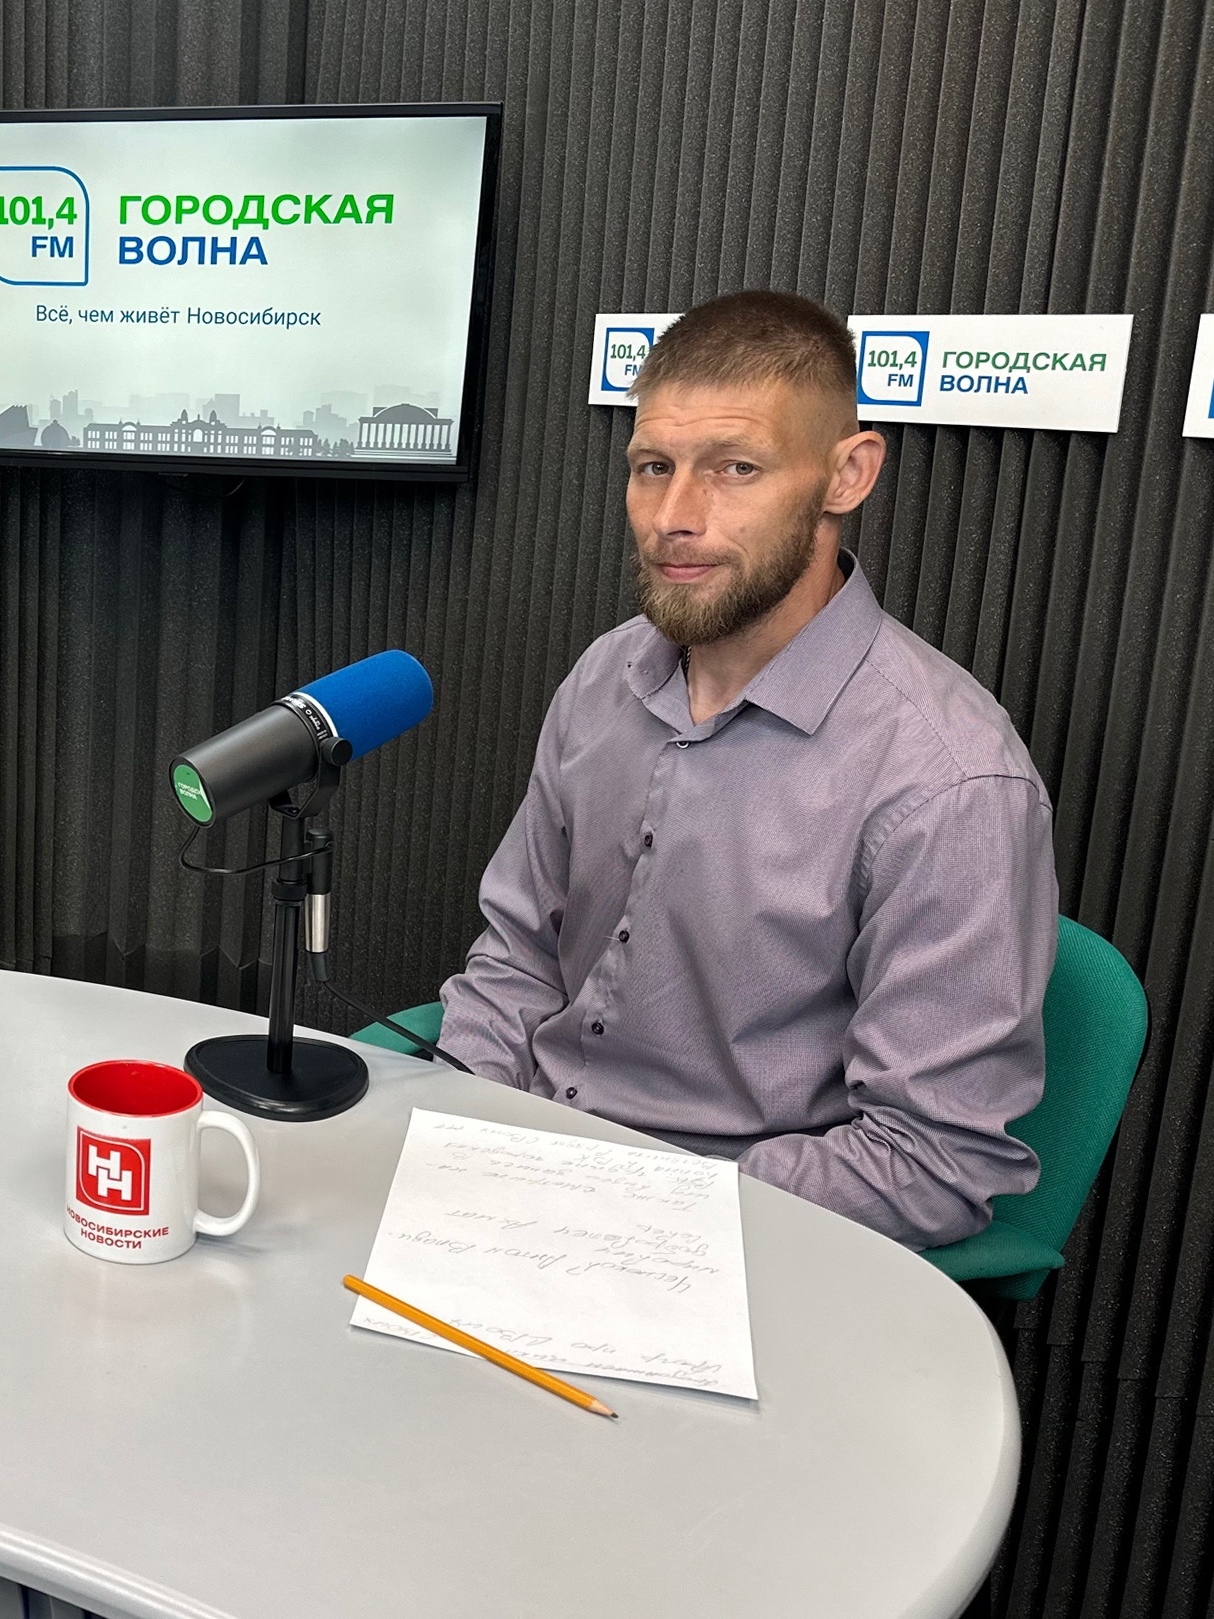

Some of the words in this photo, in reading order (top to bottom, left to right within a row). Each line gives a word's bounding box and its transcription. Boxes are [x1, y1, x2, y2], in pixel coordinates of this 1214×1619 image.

[118, 194, 395, 231] ГОРОДСКАЯ
[31, 236, 75, 258] FM
[118, 236, 268, 266] ВОЛНА
[35, 305, 73, 325] Всё,
[78, 309, 114, 324] чем
[120, 306, 181, 325] живёт
[187, 308, 322, 327] Новосибирск
[610, 344, 646, 362] 101,4
[867, 349, 918, 371] 101,4
[941, 351, 1108, 374] ГОРОДСКАЯ
[887, 373, 915, 388] FM
[939, 374, 1029, 394] ВОЛНА
[80, 1228, 142, 1249] НОВОСТИ
